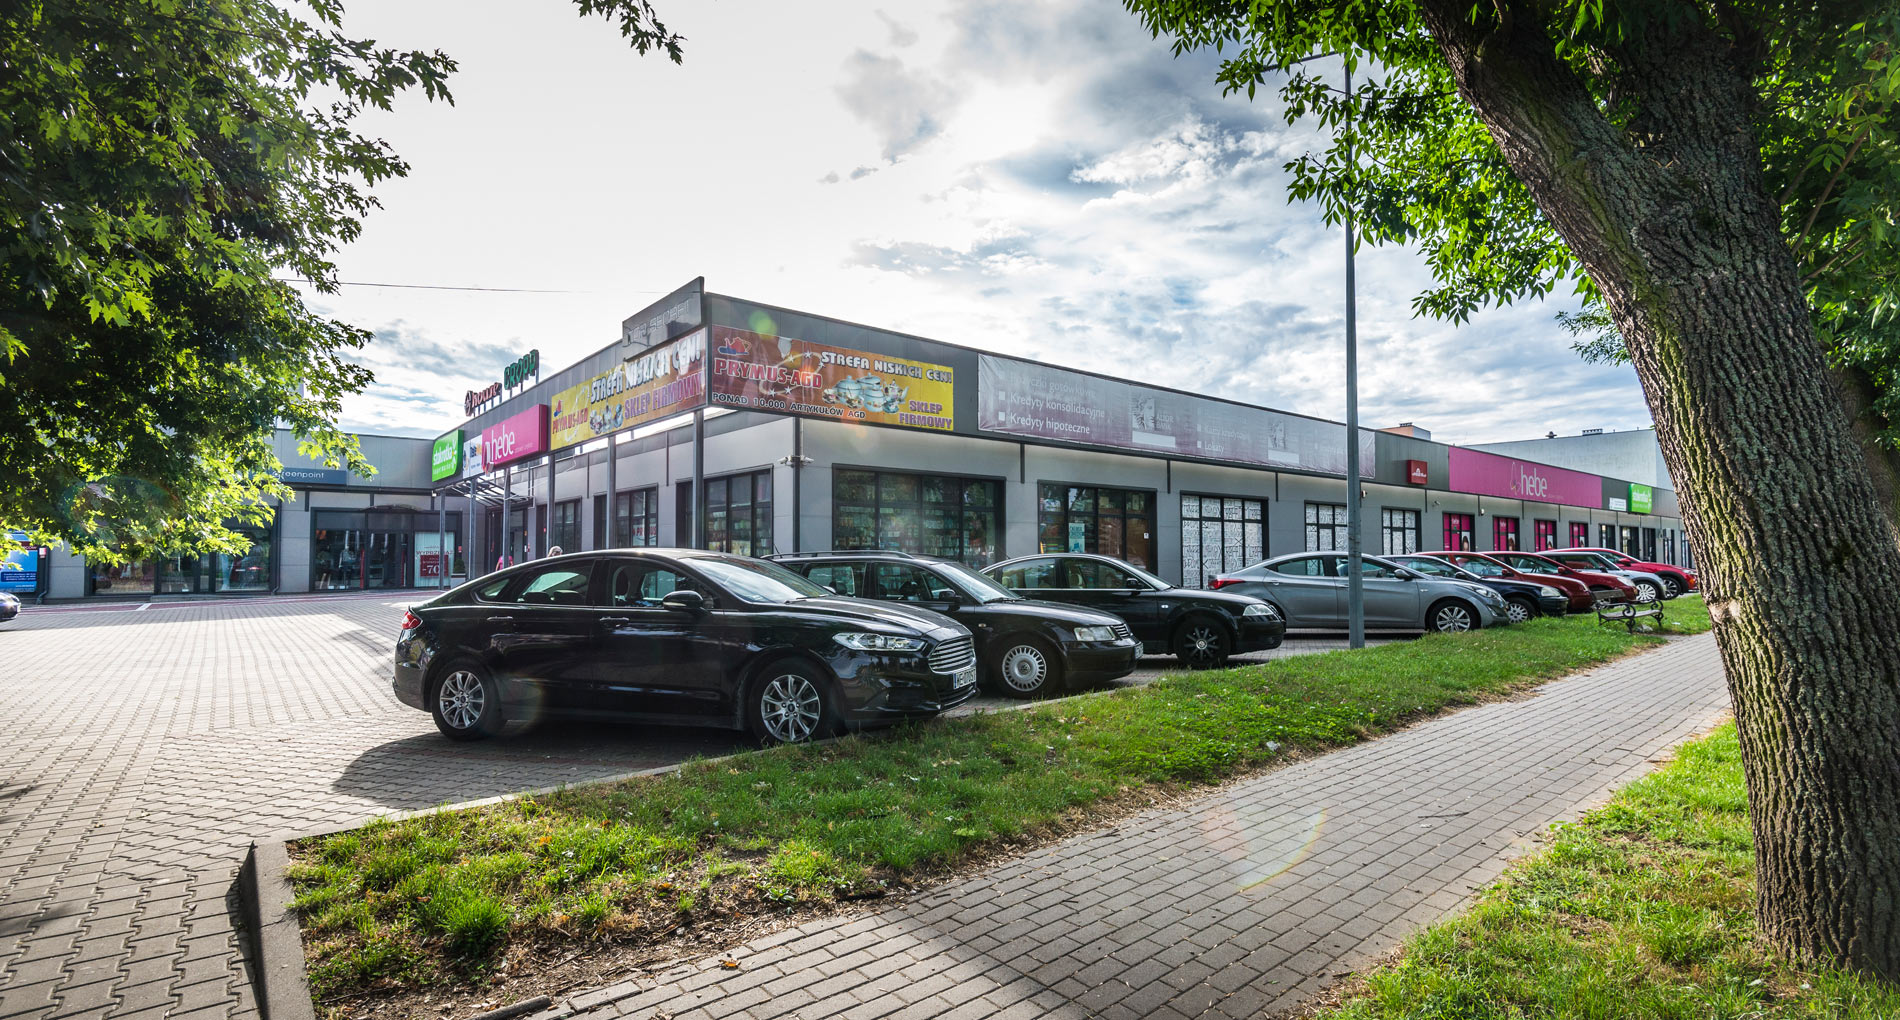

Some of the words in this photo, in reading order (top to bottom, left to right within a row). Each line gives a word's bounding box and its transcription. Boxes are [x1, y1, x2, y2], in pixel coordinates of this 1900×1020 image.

[504, 349, 539, 390] CROPP
[713, 356, 823, 390] PRYMUS-AGD
[821, 351, 870, 371] STREFA
[874, 359, 923, 380] NISKICH
[926, 368, 953, 384] CEN!
[591, 371, 624, 404] STREFA
[624, 391, 650, 420] SKLEP
[652, 371, 706, 411] FIRMOWY
[713, 393, 748, 405] PONAD
[753, 397, 785, 410] 10.000
[790, 402, 844, 417] ARTYKUŁÓW
[847, 410, 866, 420] AGD
[899, 413, 953, 430] FIRMOWY
[909, 400, 943, 415] SKLEP
[1010, 392, 1044, 411] Kredyty
[1046, 397, 1105, 420] konsolidacyjne
[1010, 412, 1045, 431] Kredyty
[1046, 416, 1090, 434] hipoteczne
[491, 424, 515, 460] hebe
[272, 470, 325, 480] reenpoint
[1521, 464, 1548, 498] hebe
